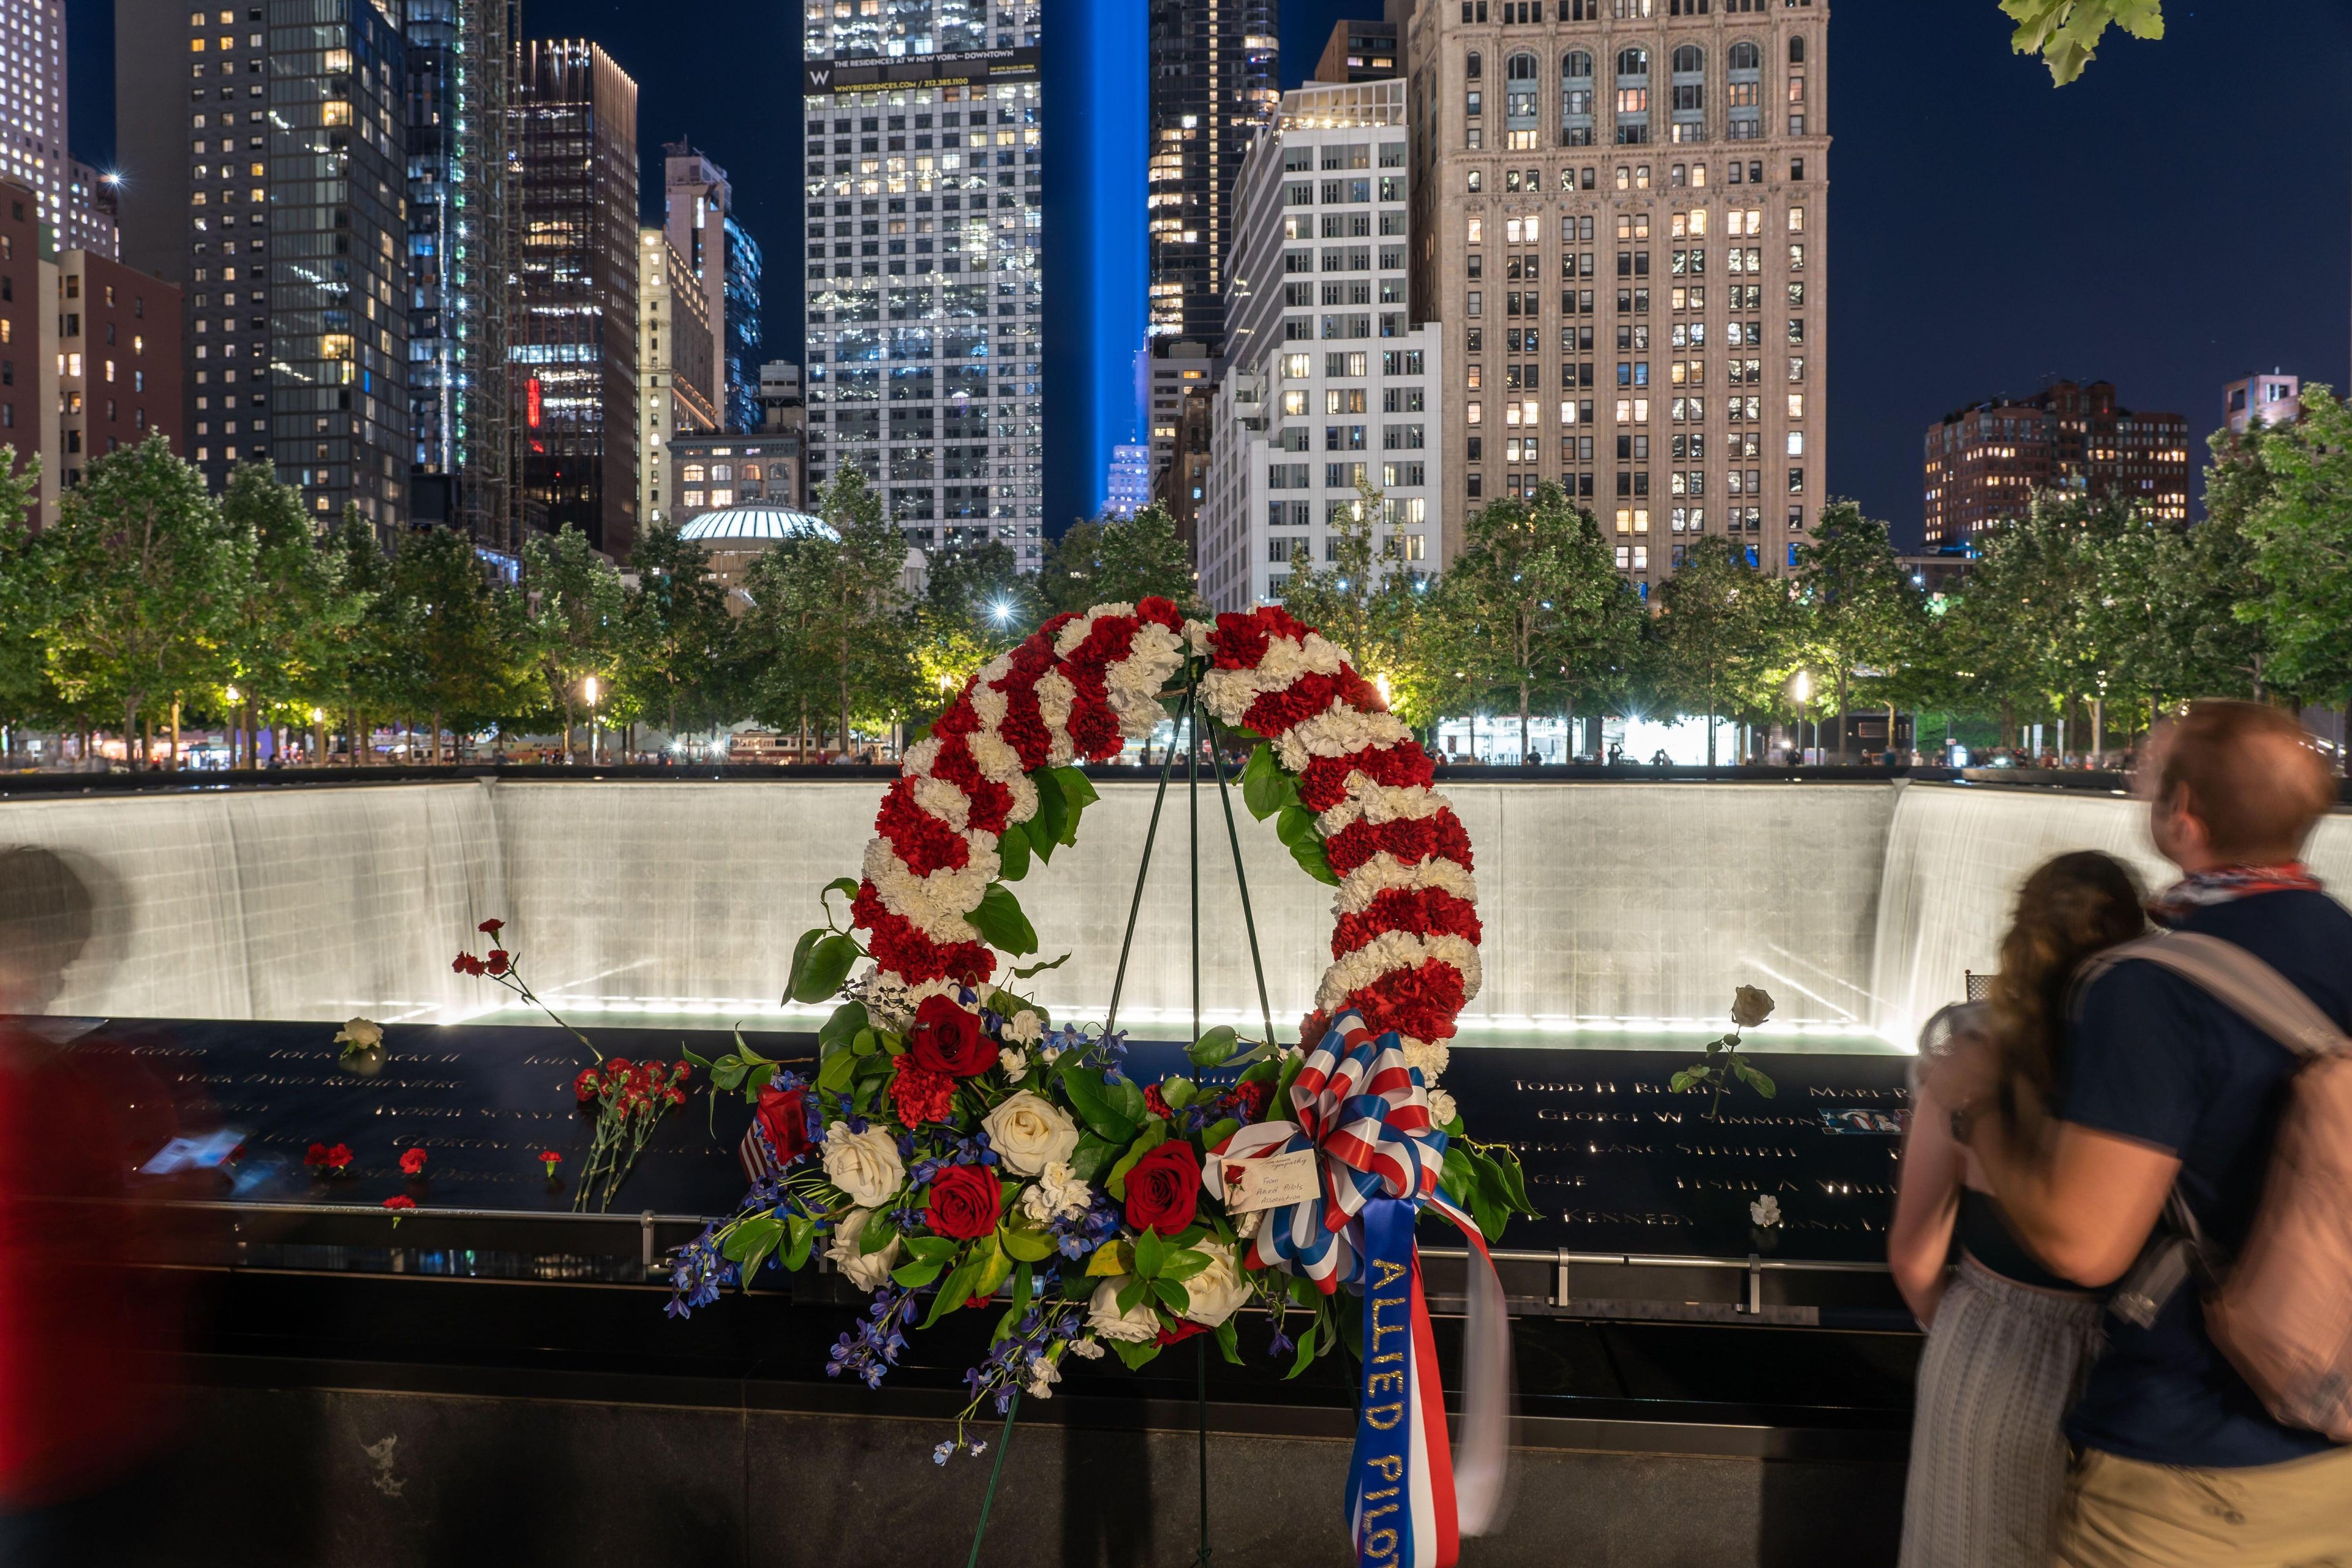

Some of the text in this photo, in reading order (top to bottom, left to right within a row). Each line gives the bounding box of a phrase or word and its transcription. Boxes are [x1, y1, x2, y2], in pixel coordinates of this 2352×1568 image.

[850, 58, 894, 67] RESIDENCES
[810, 70, 829, 85] W
[834, 81, 916, 92] WNYRESIDENCES.COM
[924, 78, 968, 87] 212.385.1100
[1510, 1079, 1583, 1091] TODD
[1272, 1157, 1306, 1170] sympathy
[1365, 1258, 1407, 1430] ALLIED
